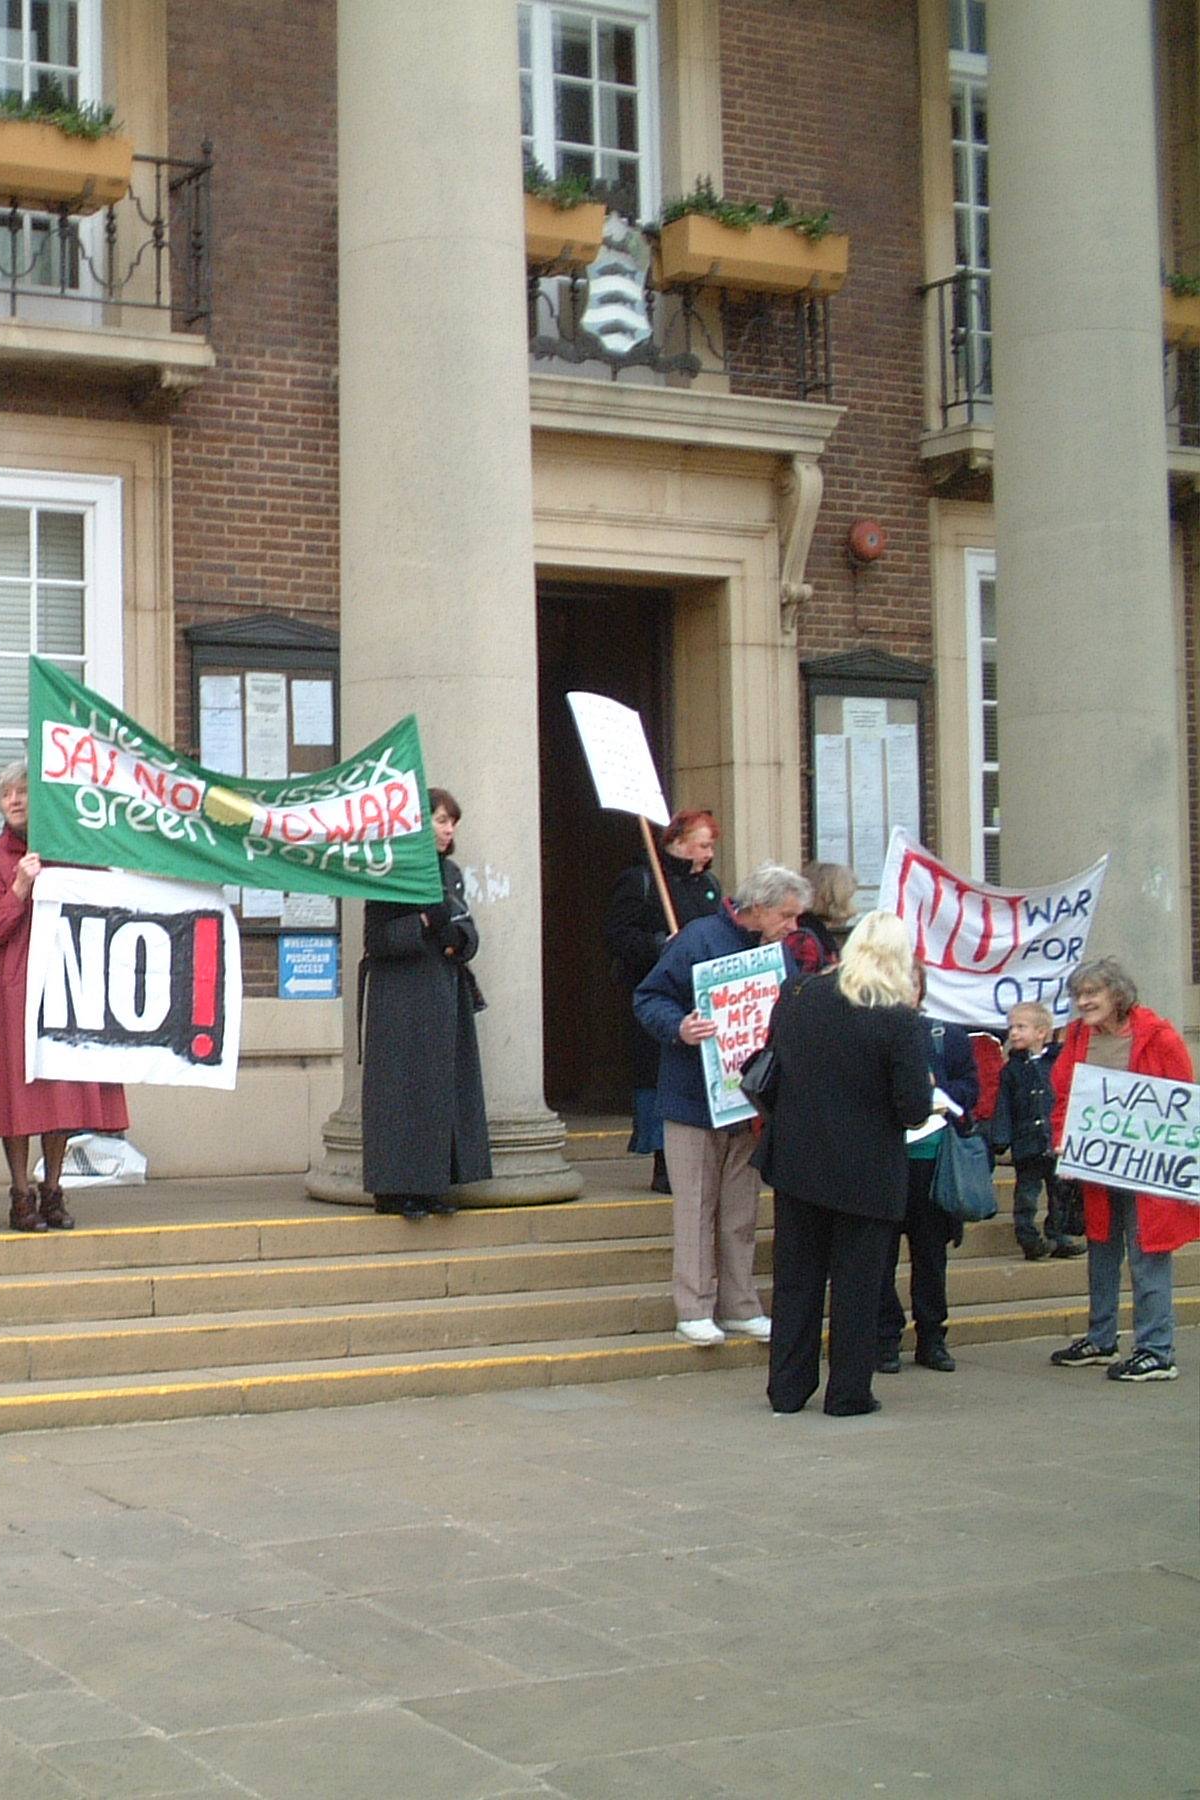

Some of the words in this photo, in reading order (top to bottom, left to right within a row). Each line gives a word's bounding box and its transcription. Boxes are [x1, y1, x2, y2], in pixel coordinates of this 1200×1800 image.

[134, 763, 201, 812] NO
[74, 785, 217, 846] green
[242, 836, 394, 877] party
[896, 848, 1026, 974] NO
[1024, 889, 1093, 927] WAR
[711, 956, 748, 981] GREEN
[1021, 936, 1084, 963] FOR
[42, 914, 220, 1057] NO!
[709, 980, 780, 1010] Worthing
[716, 1029, 750, 1052] Vote
[1102, 1076, 1192, 1122] WAR
[1078, 1105, 1200, 1149] SOLVES
[1062, 1134, 1200, 1189] NOTHING
